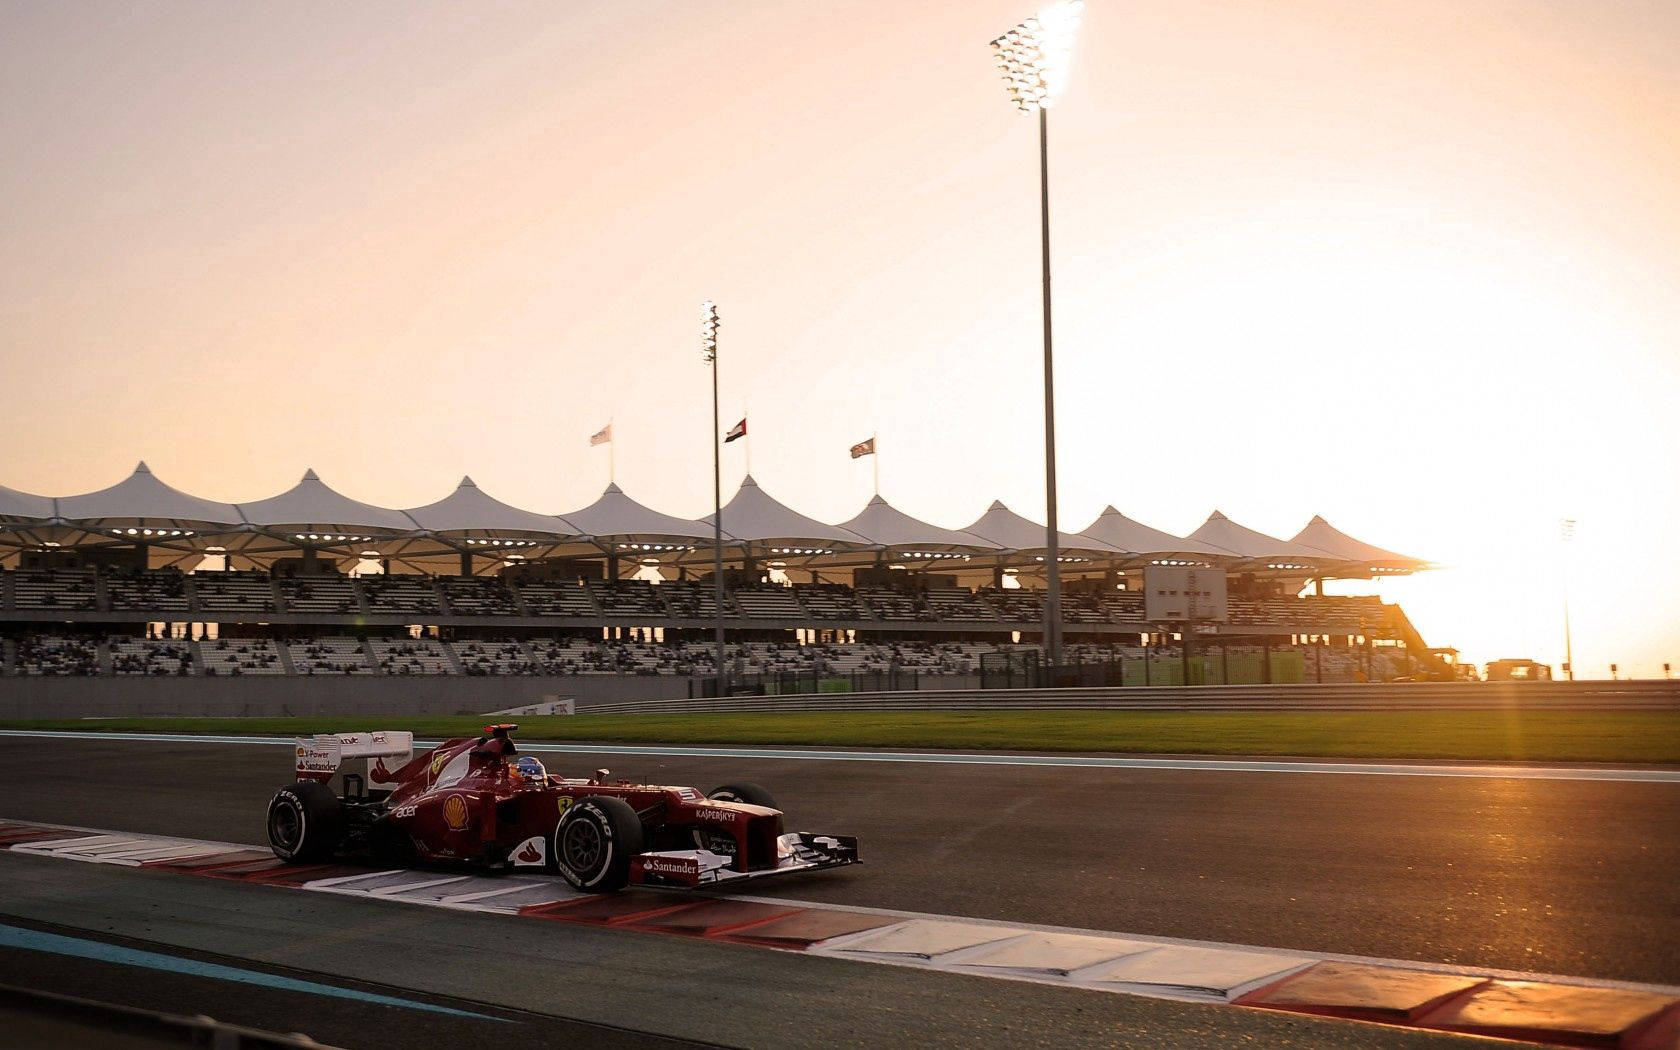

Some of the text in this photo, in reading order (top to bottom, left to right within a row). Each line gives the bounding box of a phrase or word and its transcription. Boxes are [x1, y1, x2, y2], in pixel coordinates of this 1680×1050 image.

[305, 761, 336, 771] Santander
[396, 805, 418, 818] acer
[695, 808, 732, 822] KASPERSKY
[653, 859, 697, 874] Santander
